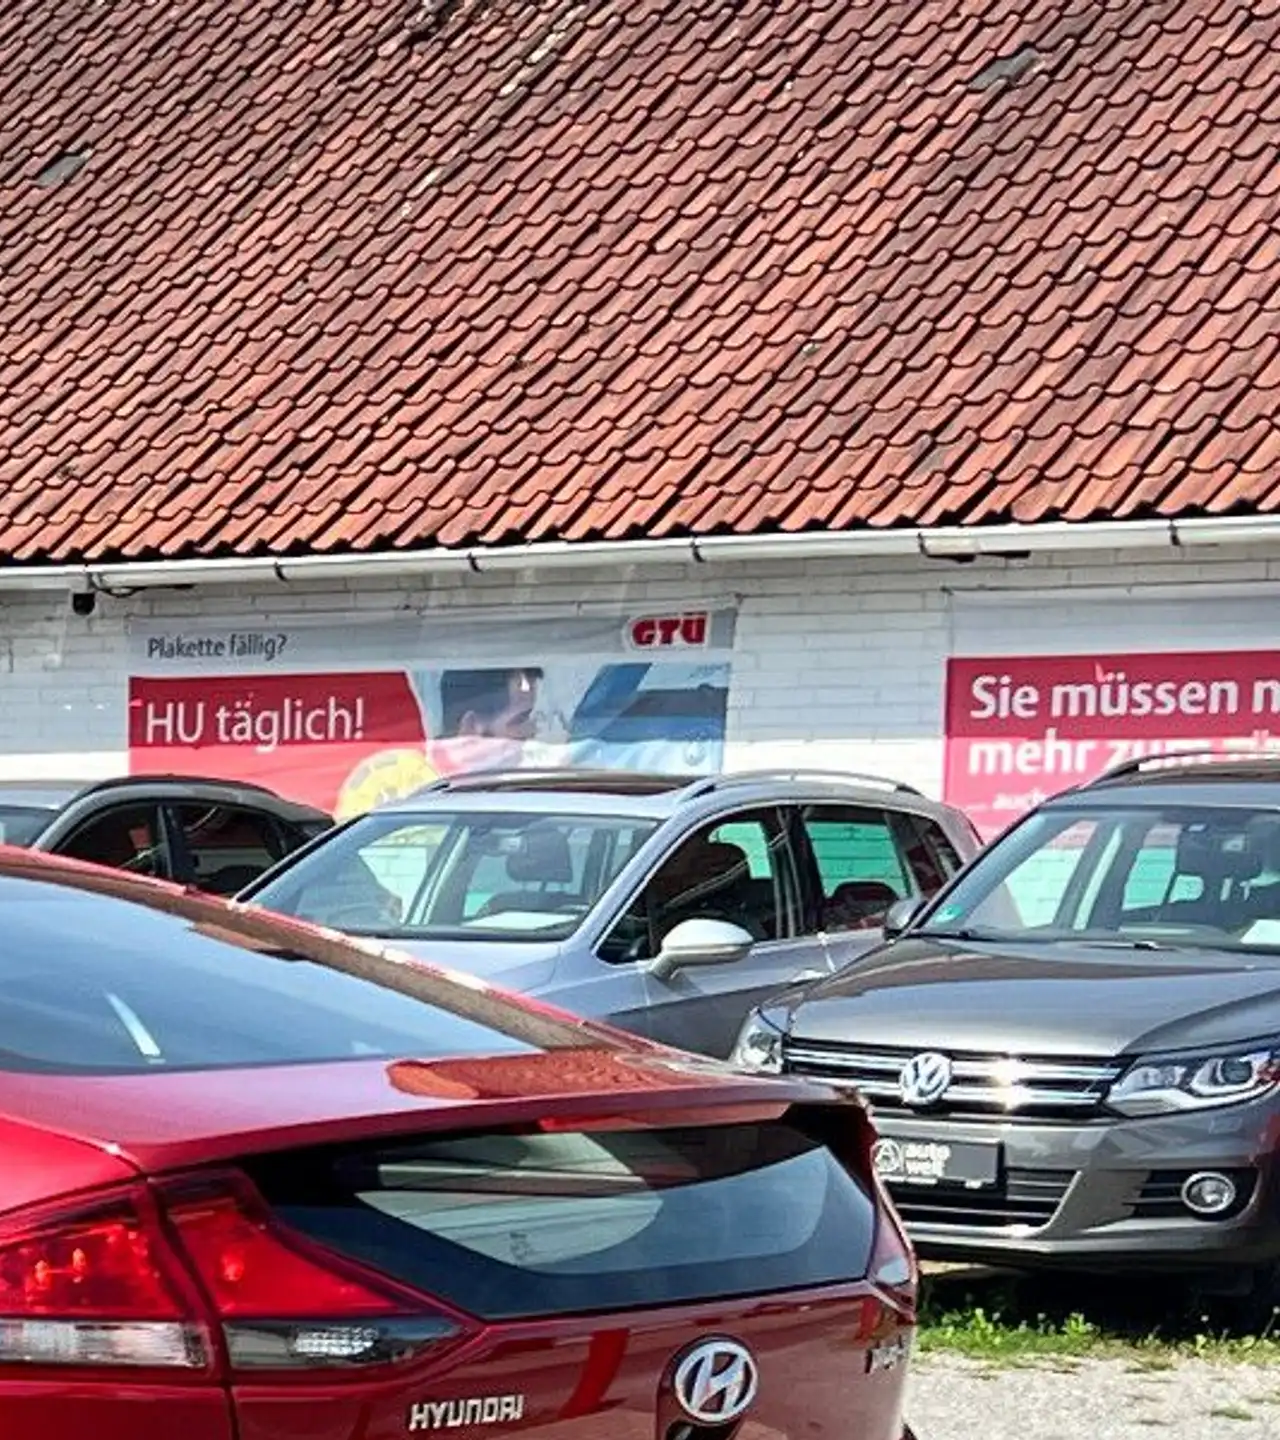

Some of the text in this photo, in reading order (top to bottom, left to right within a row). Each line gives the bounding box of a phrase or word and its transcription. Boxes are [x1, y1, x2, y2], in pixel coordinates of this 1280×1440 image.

[148, 633, 287, 661] Plakette fällig?
[632, 611, 706, 645] GTÜ
[969, 675, 1038, 719] Sie
[1050, 671, 1238, 717] müssen
[146, 696, 364, 754] HU täglich!
[968, 728, 1097, 776] mehr
[409, 1394, 524, 1432] HYUNDAI
